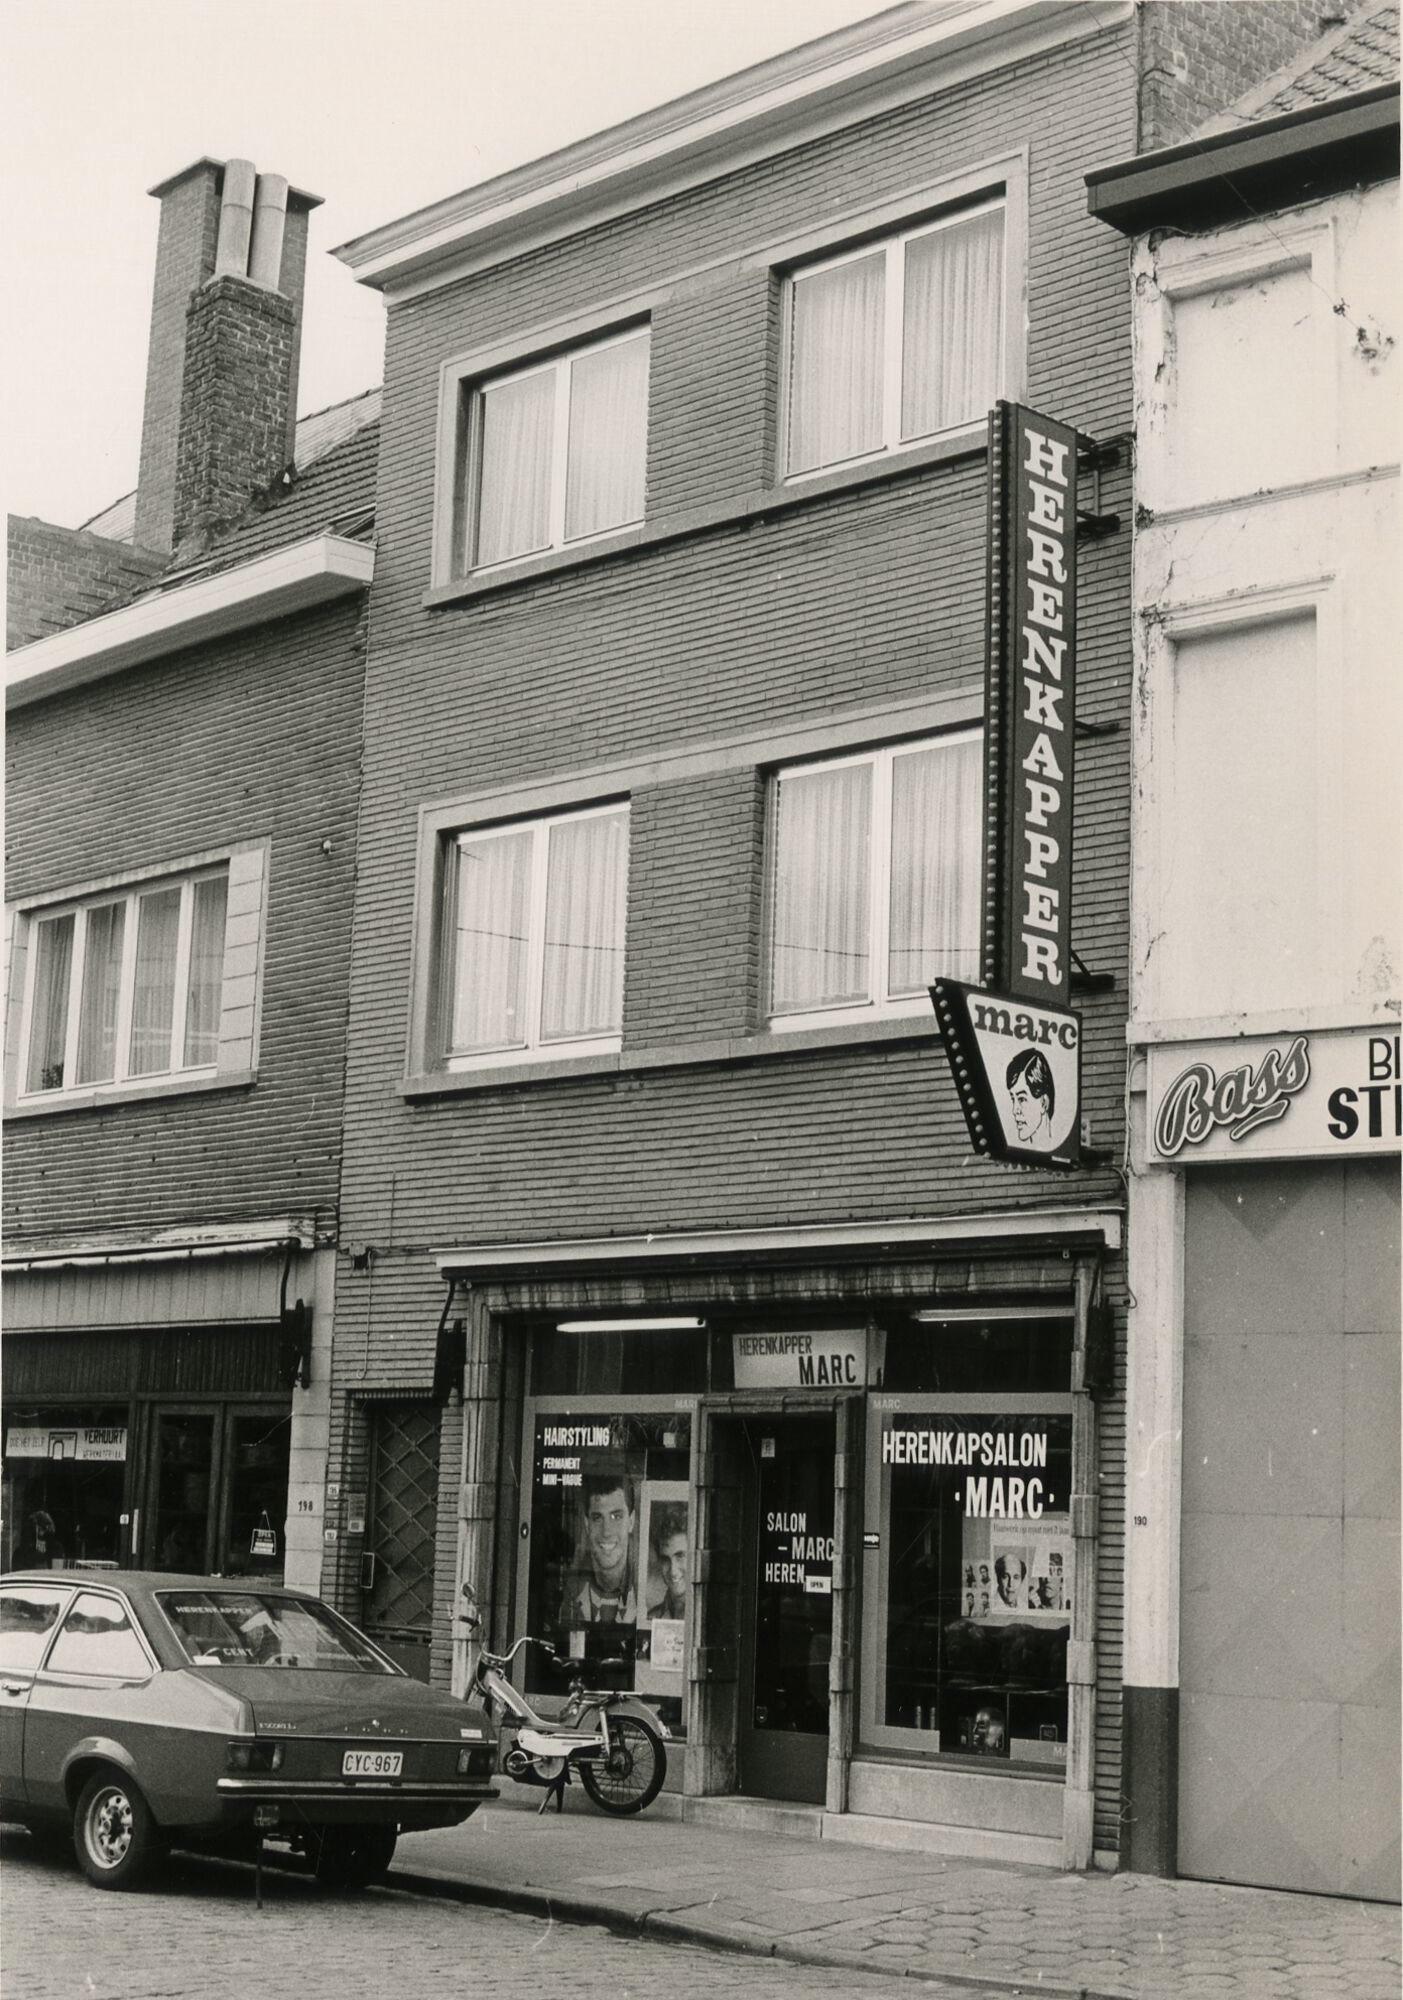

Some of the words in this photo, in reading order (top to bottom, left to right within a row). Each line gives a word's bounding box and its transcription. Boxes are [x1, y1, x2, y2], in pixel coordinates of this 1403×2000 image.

[1021, 427, 1070, 987] HERENKAPPER
[973, 1003, 1078, 1050] marc
[1154, 1036, 1311, 1157] Bass
[739, 1335, 813, 1356] HERENKAPPER
[798, 1354, 857, 1385] MARC
[674, 1399, 698, 1409] MAR
[84, 1430, 125, 1444] VERHUURT
[544, 1427, 610, 1447] HAIRSTYLING
[882, 1430, 1048, 1468] HERENKAPSALON
[543, 1457, 581, 1470] PERMANENT
[965, 1476, 1044, 1520] MARC
[767, 1512, 807, 1533] SALON
[1134, 1515, 1148, 1526] 190
[792, 1537, 834, 1562] MARC
[765, 1563, 805, 1584] HEREN
